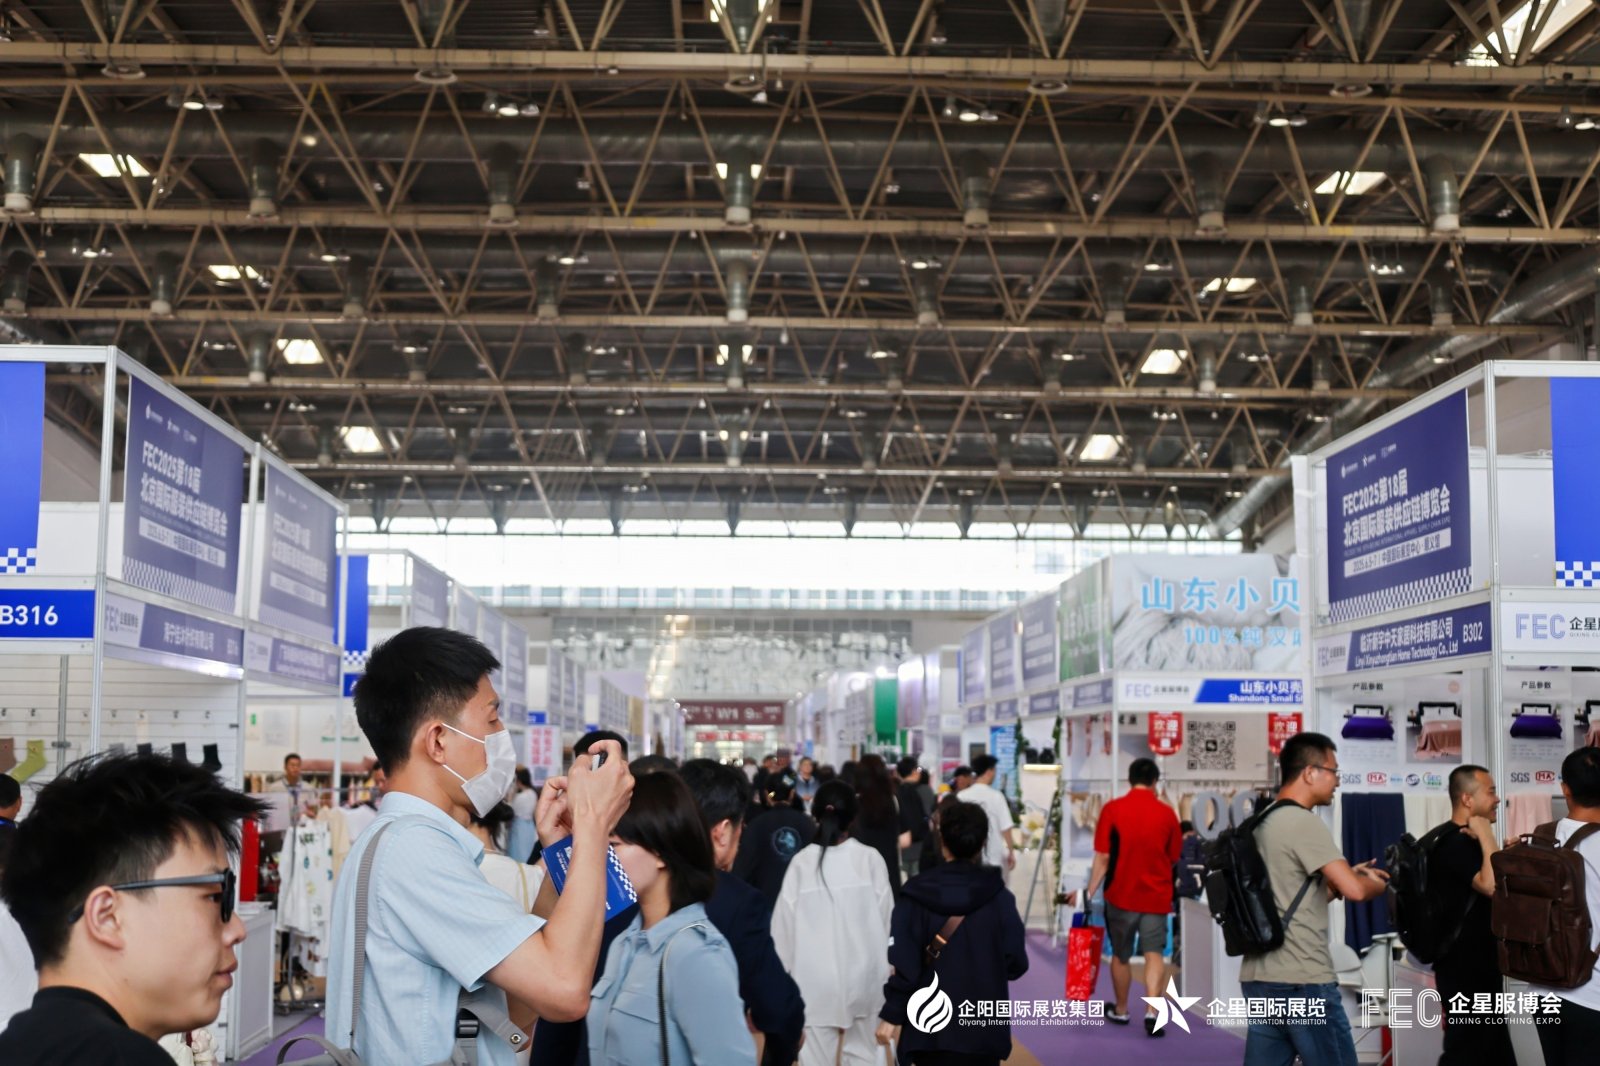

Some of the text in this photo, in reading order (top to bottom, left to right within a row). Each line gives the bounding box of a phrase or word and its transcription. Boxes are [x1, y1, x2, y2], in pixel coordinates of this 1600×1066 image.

[1343, 468, 1408, 517] FEC2025第18届
[1344, 483, 1450, 547] 北京国际服装供应链博览会
[0, 604, 59, 626] B316
[1569, 616, 1600, 630] 企星
[1463, 622, 1483, 643] B302
[1516, 613, 1565, 639] FEC
[1126, 684, 1151, 697] FEC
[1341, 774, 1361, 784] SGS
[1511, 772, 1530, 783] SGS
